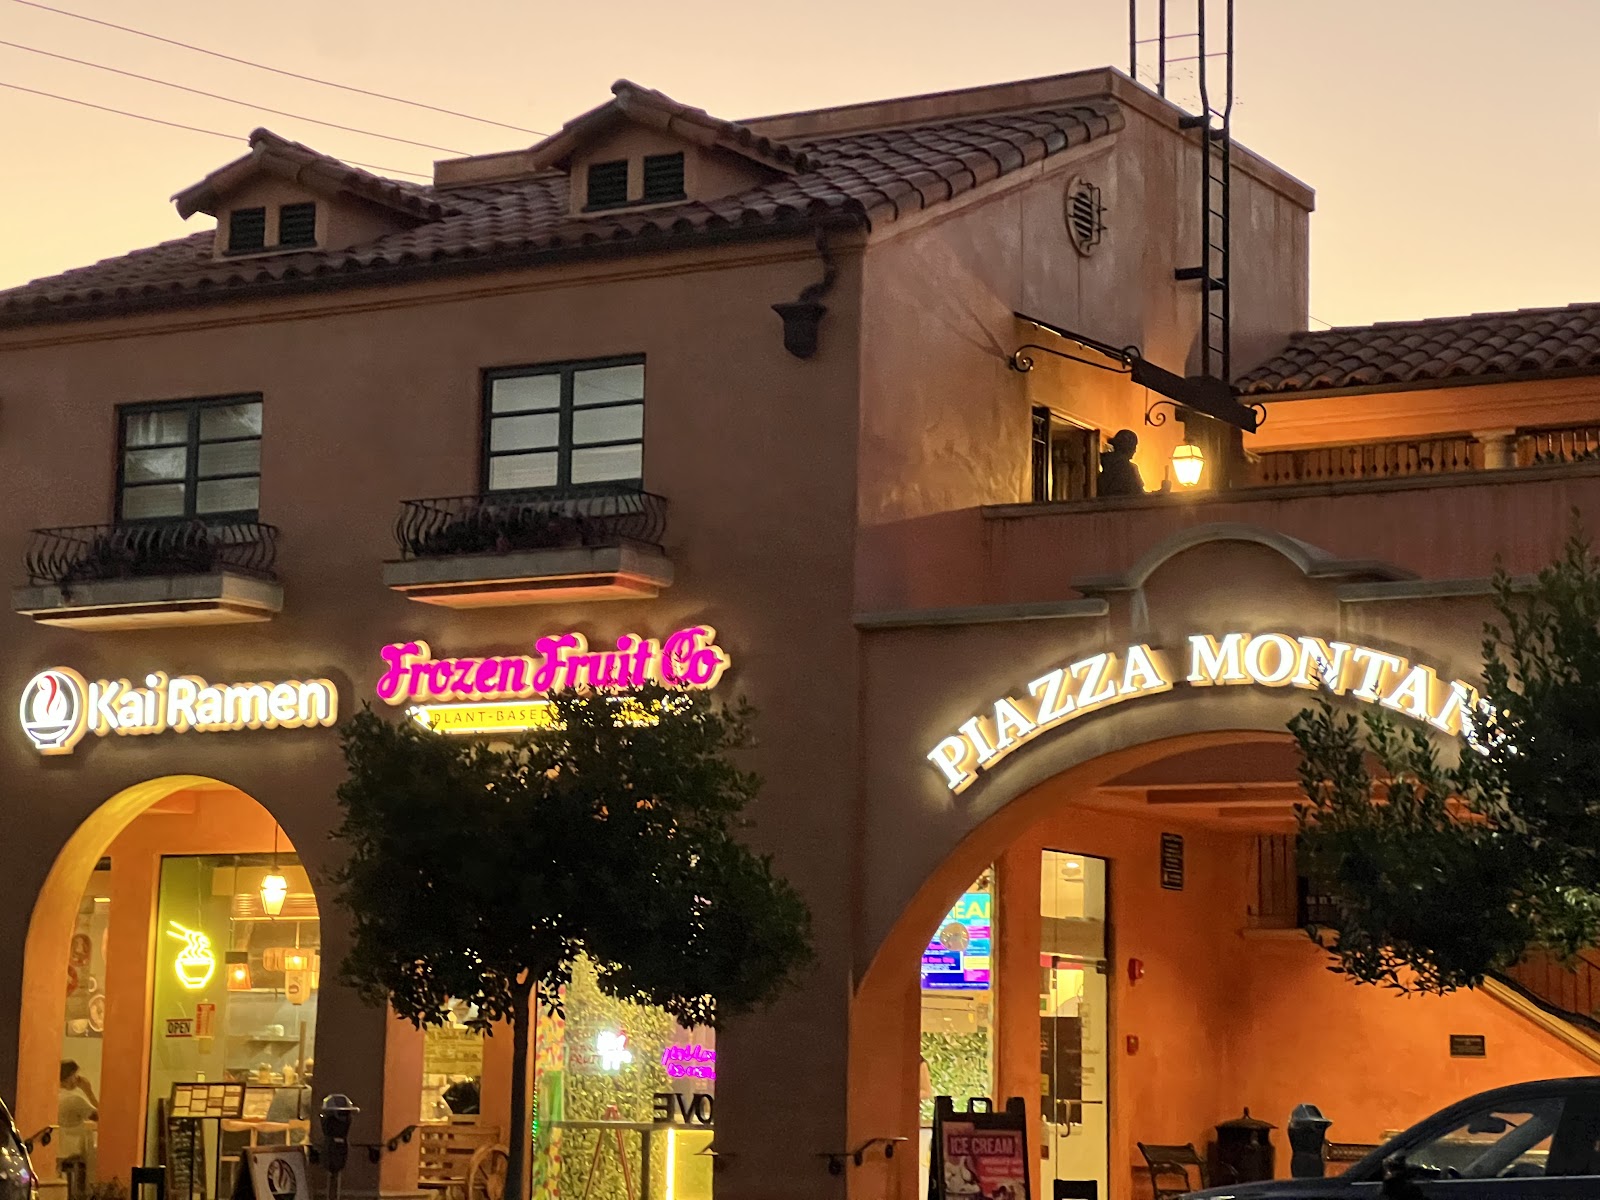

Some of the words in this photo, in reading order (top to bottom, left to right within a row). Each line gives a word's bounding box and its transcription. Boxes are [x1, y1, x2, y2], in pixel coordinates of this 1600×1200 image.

[377, 641, 529, 700] Frozen
[534, 632, 655, 690] Fruit
[661, 624, 725, 686] Co
[88, 673, 158, 730] Kai
[166, 677, 327, 727] Ramen
[434, 708, 550, 724] PLANT-BASED
[926, 643, 1168, 792] PIAZZA
[1188, 633, 1510, 758] MONTAN
[167, 1022, 190, 1034] OPEN
[950, 1136, 969, 1154] ICE
[971, 1137, 1014, 1155] CREAM
